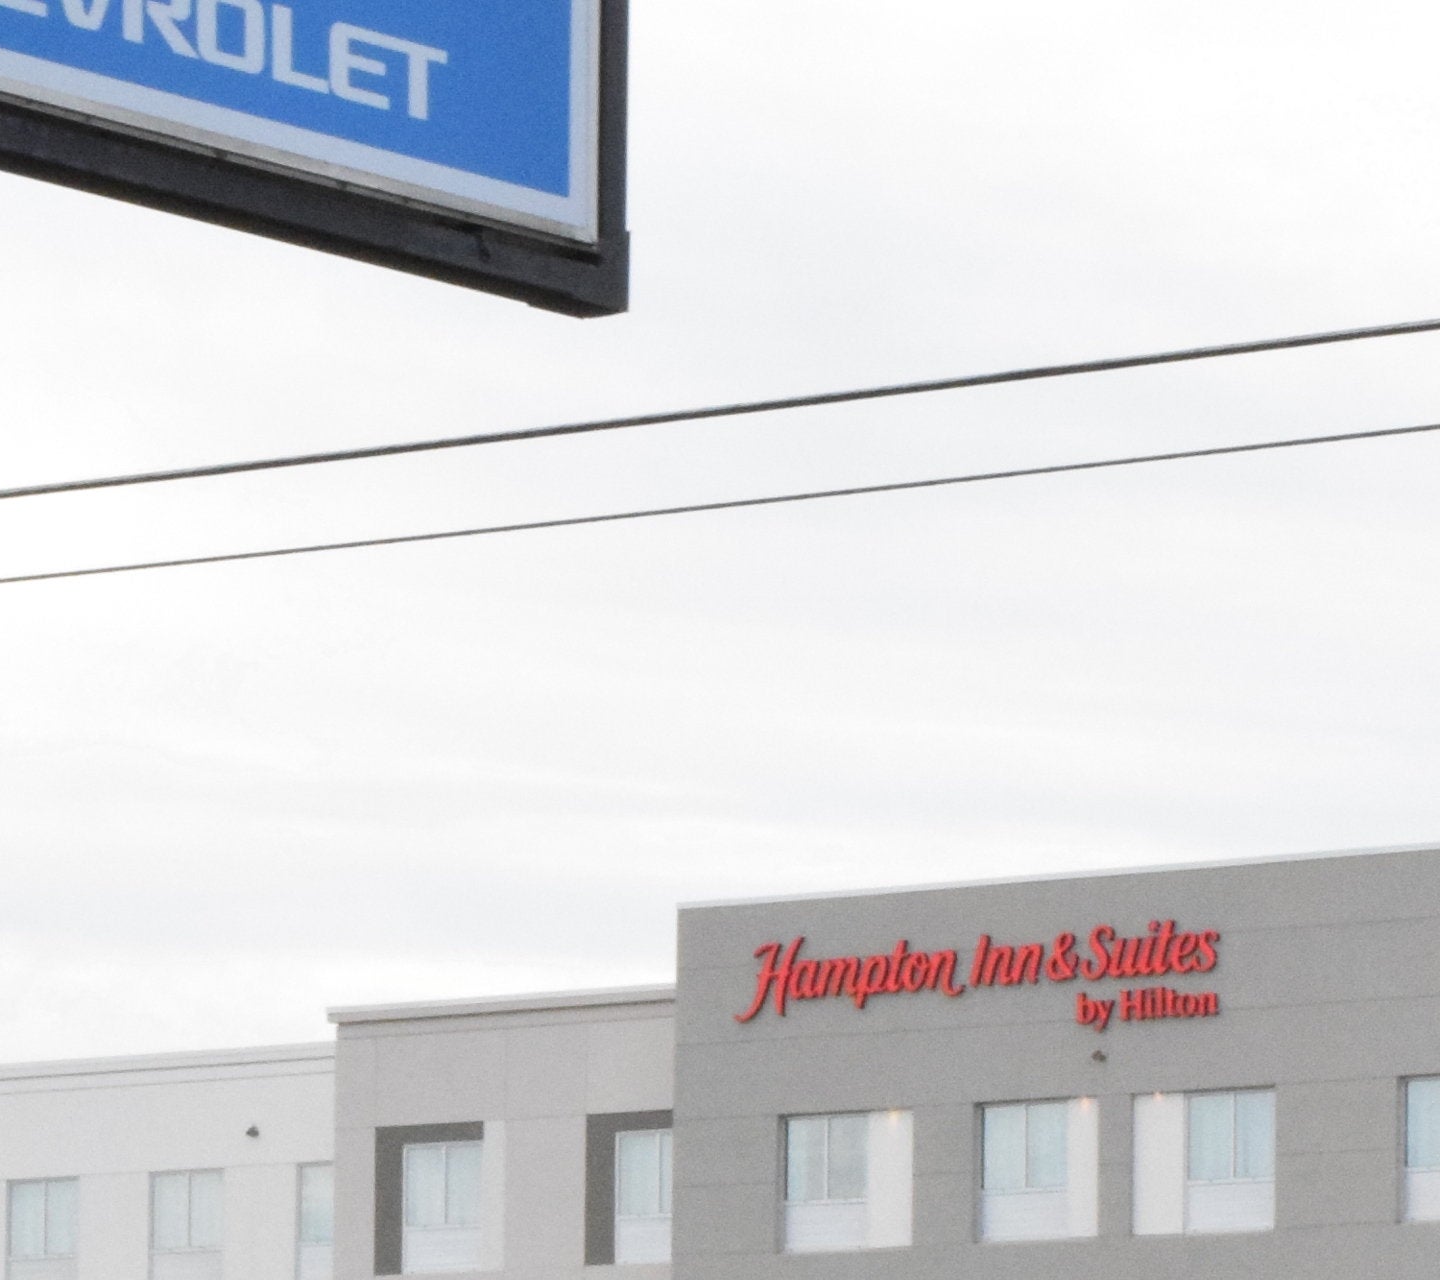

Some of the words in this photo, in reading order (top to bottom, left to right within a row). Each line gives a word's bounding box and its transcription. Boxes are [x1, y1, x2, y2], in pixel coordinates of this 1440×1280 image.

[734, 935, 964, 1023] Hampton
[1075, 992, 1114, 1032] by
[1118, 986, 1220, 1021] Hilton
